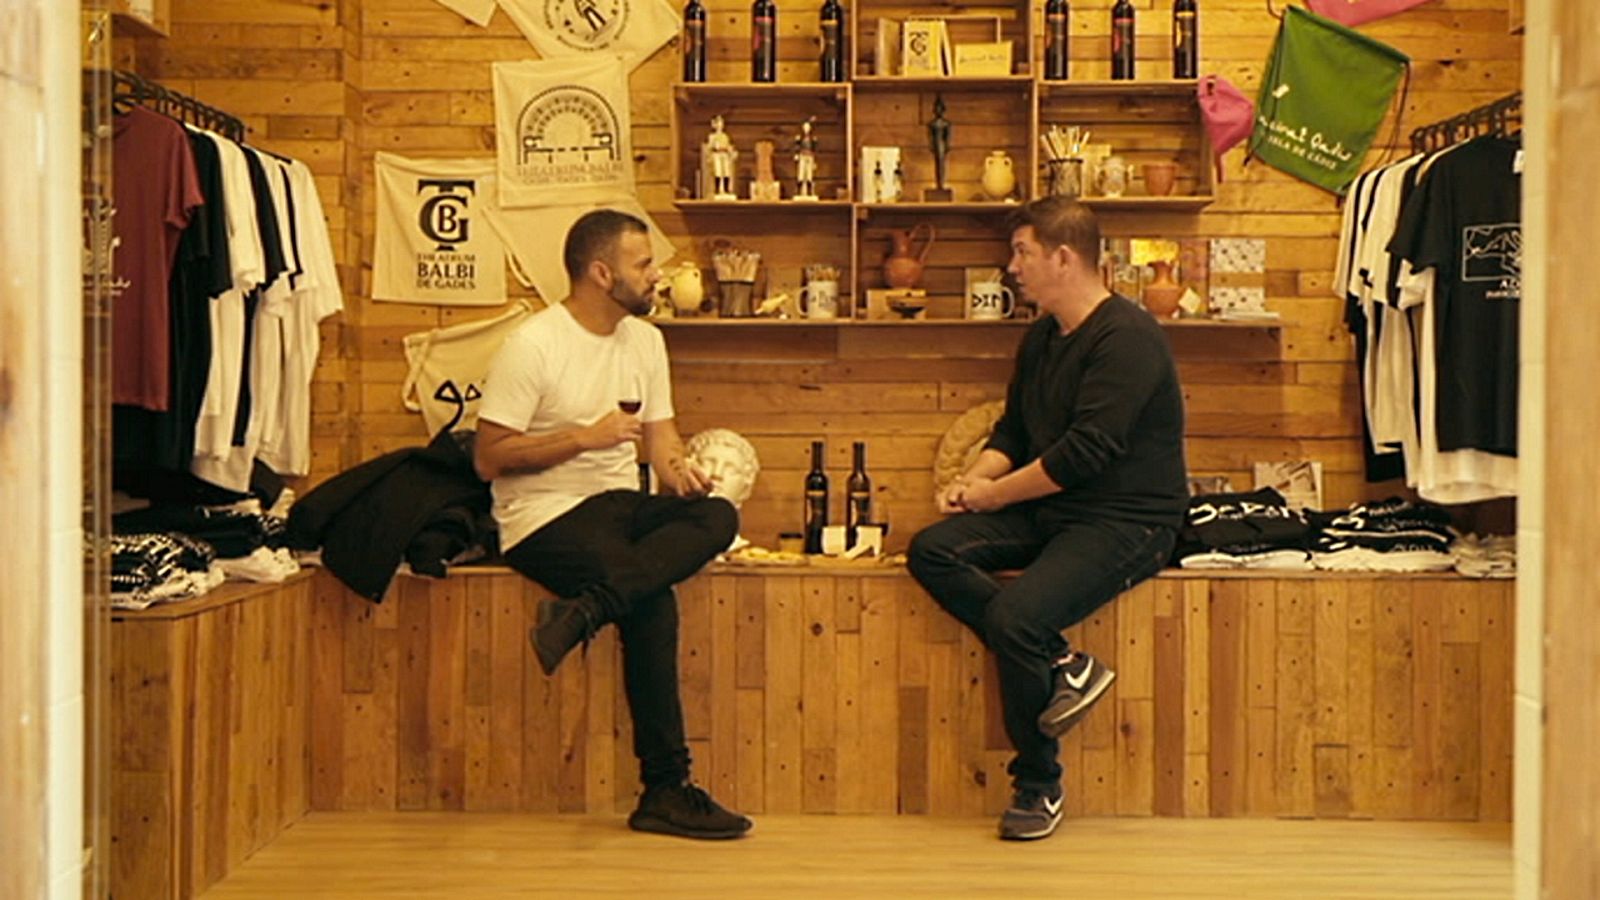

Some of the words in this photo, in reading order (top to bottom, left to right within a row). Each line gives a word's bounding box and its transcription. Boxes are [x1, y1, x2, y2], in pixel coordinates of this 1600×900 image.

[417, 262, 475, 279] BALBI
[416, 279, 431, 289] DE
[434, 280, 476, 290] GADES
